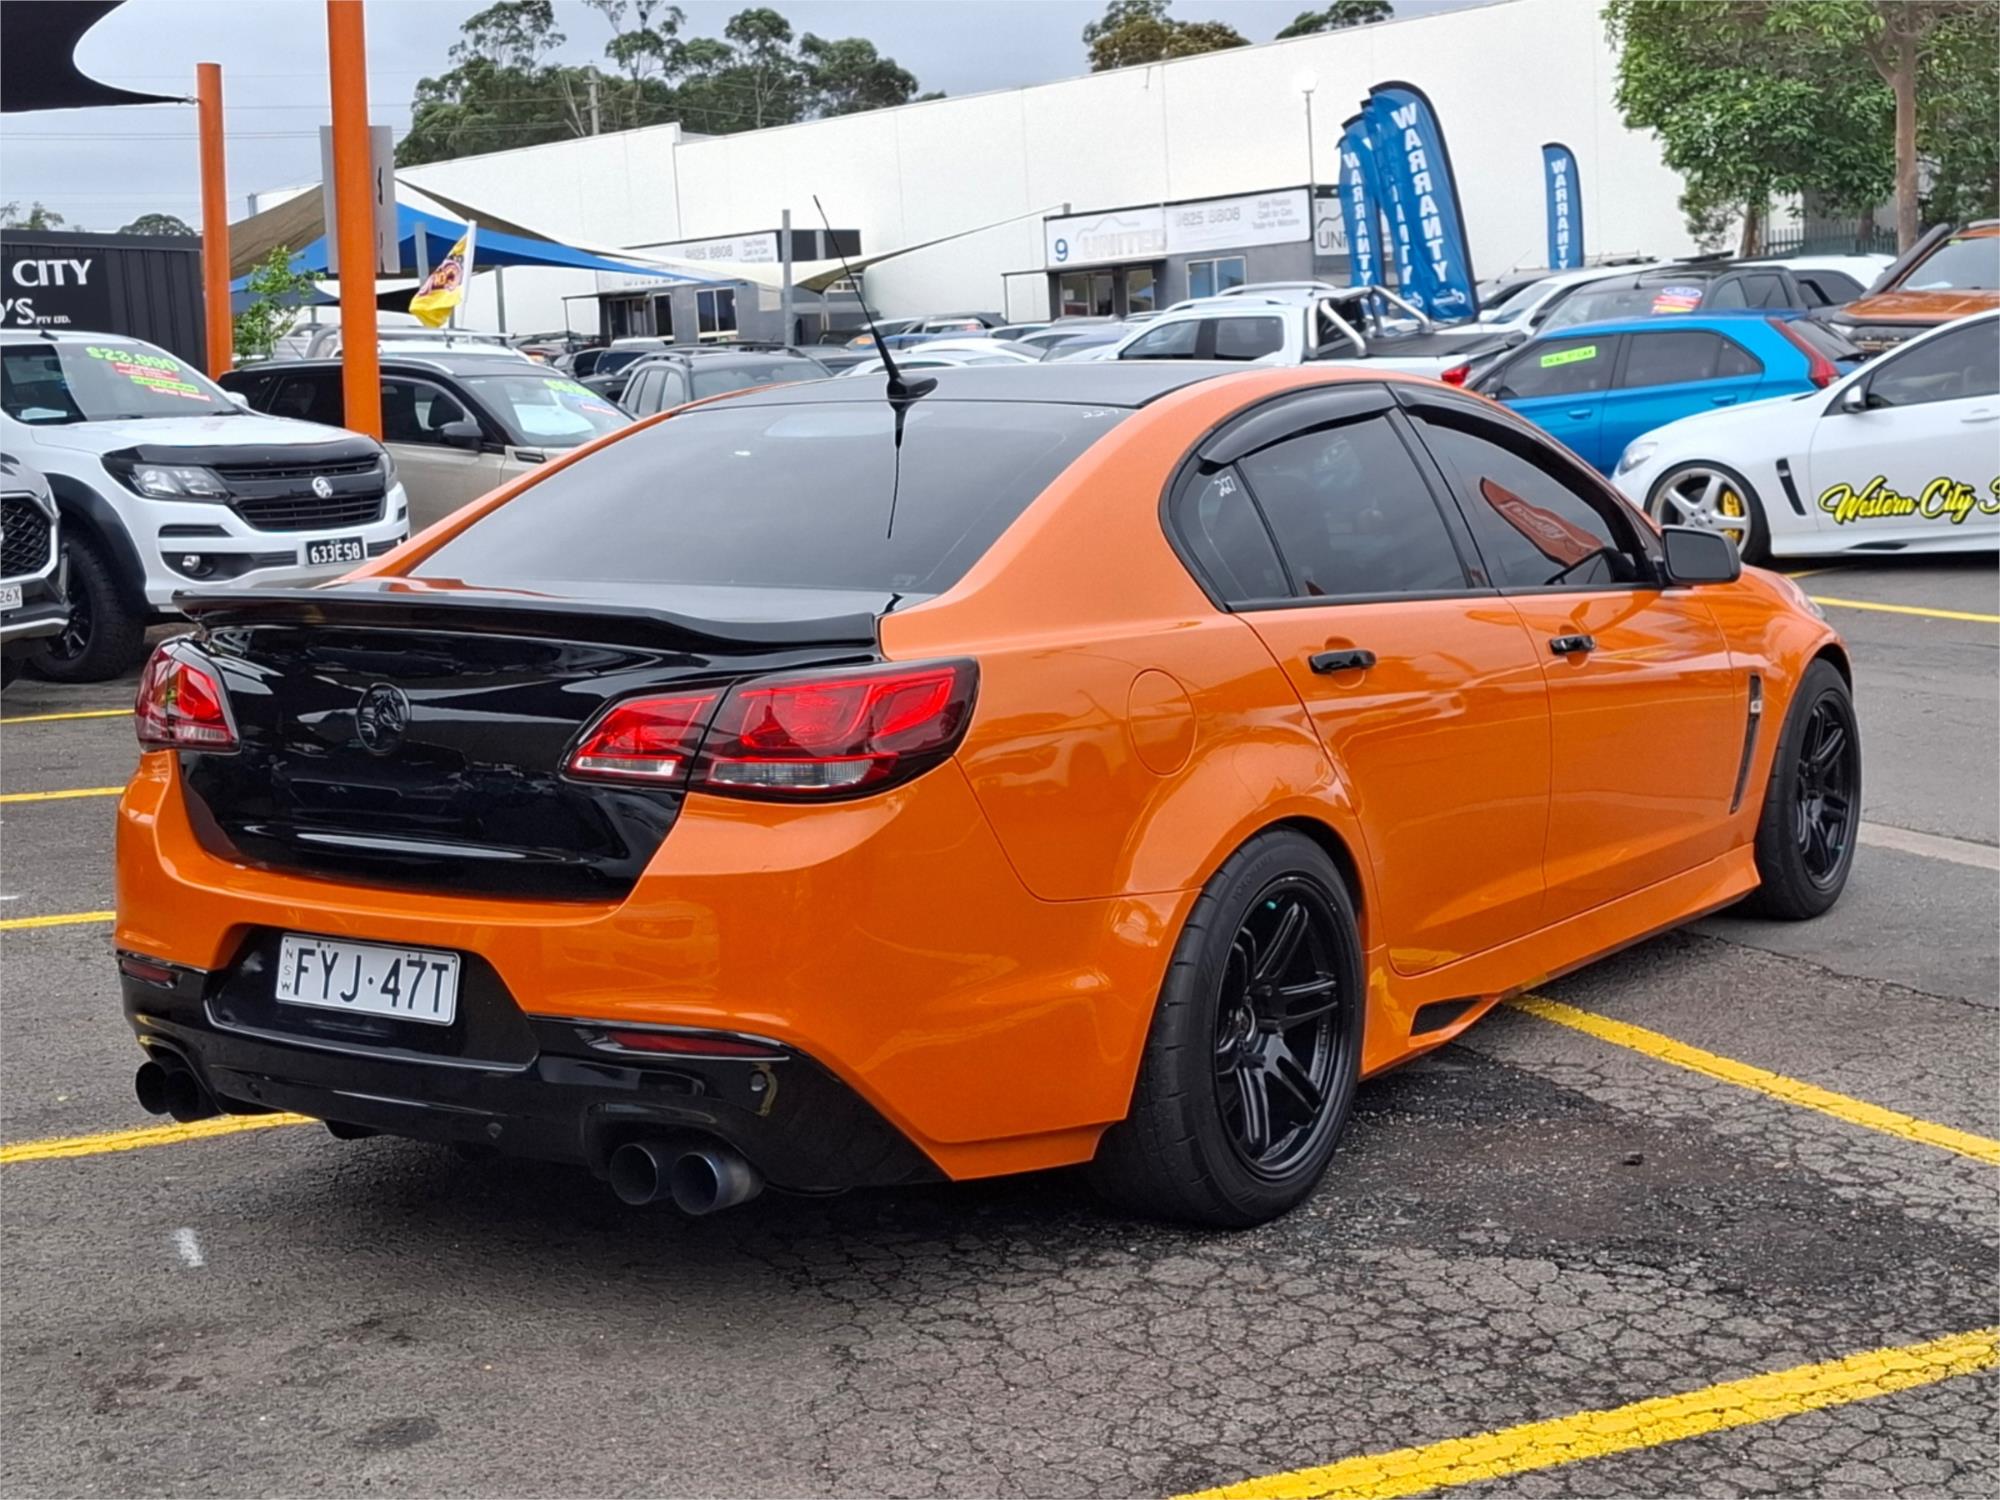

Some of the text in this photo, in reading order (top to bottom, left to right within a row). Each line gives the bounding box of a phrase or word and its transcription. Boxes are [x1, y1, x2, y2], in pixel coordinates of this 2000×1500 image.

[1054, 238, 1069, 262] 9
[12, 259, 92, 287] CITY
[1818, 475, 1915, 525] Western
[1919, 476, 1977, 524] City
[281, 948, 293, 992] NSW
